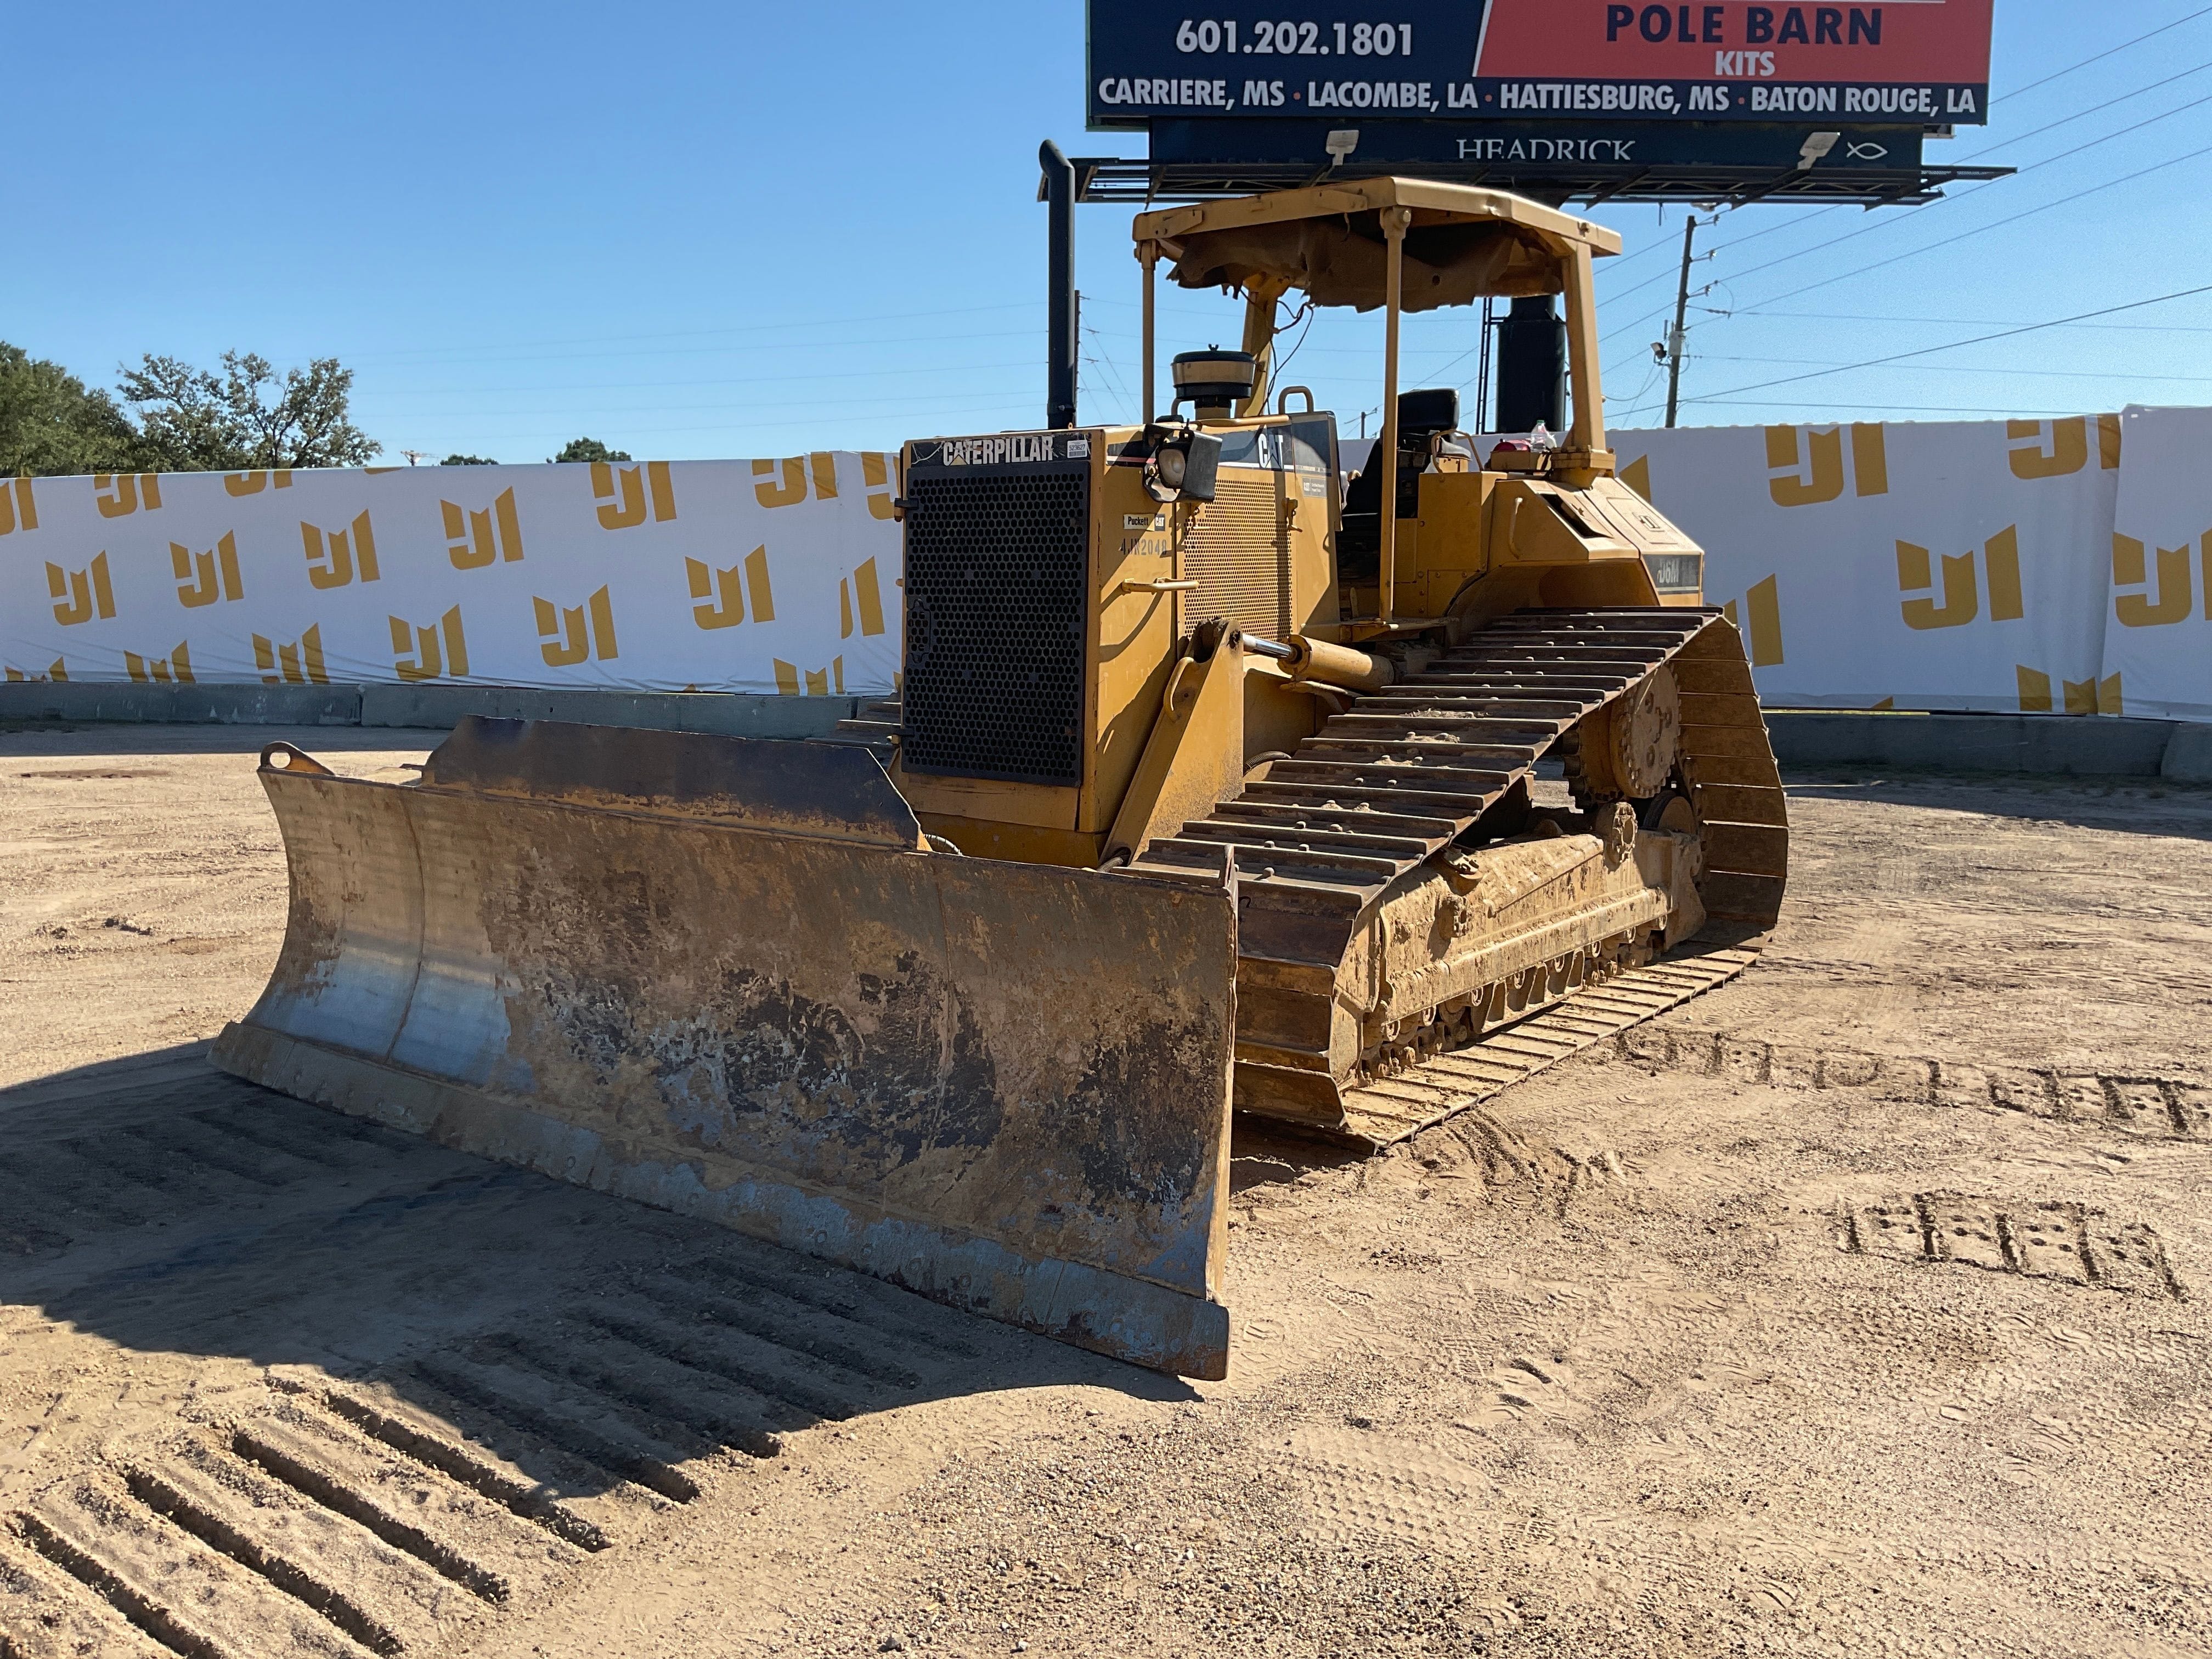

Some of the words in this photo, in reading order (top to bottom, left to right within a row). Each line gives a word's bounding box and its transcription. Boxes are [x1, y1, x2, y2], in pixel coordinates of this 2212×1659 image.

[1176, 20, 1412, 55] 601.202.1801
[1606, 4, 1724, 43] POLE
[1747, 7, 1882, 45] BARN
[1715, 50, 1775, 77] KITS
[1098, 77, 1235, 111] CARRIERE,
[1243, 80, 1285, 106] MS
[1308, 81, 1439, 112] LACOMBE,
[1447, 83, 1479, 109] LA
[1500, 83, 1681, 115] HATTIESBURG,
[1689, 86, 1729, 111] MS
[1751, 86, 1837, 112] BATON
[1845, 88, 1939, 117] ROUGE,
[1946, 88, 1976, 113] LA
[1456, 139, 1635, 160] HEADRICK
[943, 436, 1053, 466] CATERPILLAR
[1258, 433, 1283, 469] CAT
[1128, 516, 1148, 526] Puckett
[1155, 517, 1165, 527] CAT
